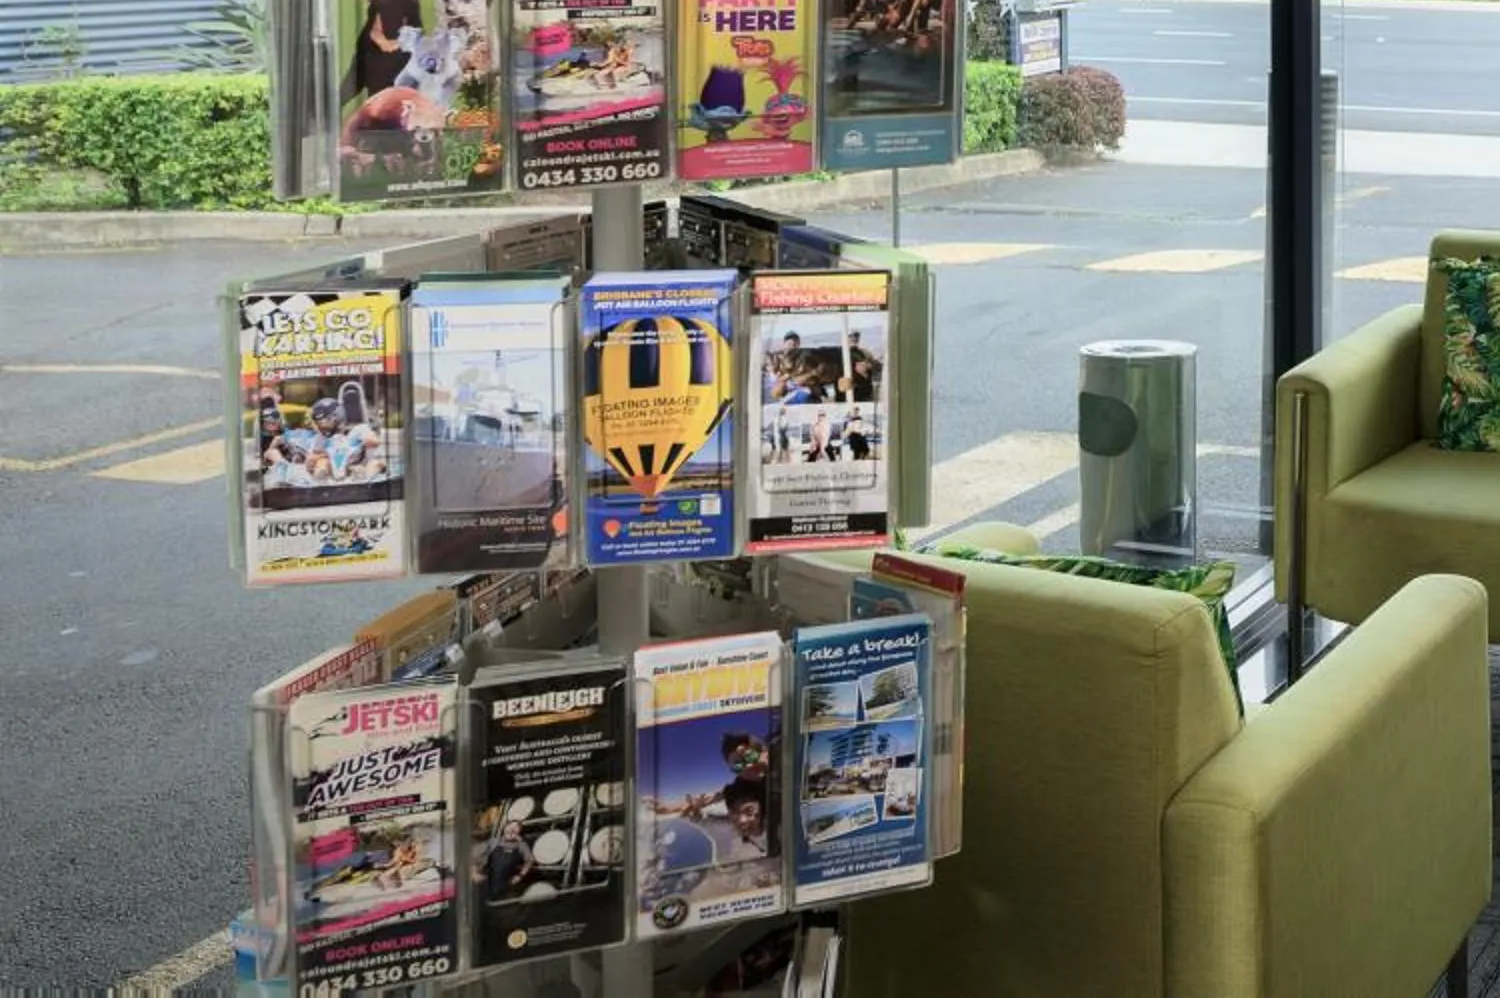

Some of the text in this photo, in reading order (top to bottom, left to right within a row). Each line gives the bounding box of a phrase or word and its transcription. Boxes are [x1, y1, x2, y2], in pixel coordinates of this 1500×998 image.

[715, 9, 796, 33] HERE
[545, 135, 638, 154] BOOK ONLINE
[523, 161, 661, 189] 0434 330 660
[325, 308, 372, 331] GO
[257, 520, 341, 540] KINGSTON
[801, 631, 919, 661] Take a break!
[493, 686, 606, 721] BEENLEIGH
[341, 700, 439, 738] JETSKI
[333, 747, 394, 779] JUST
[308, 753, 438, 807] AWESOME
[325, 945, 368, 963] BOOK
[363, 965, 404, 987] 330
[407, 956, 450, 979] 660
